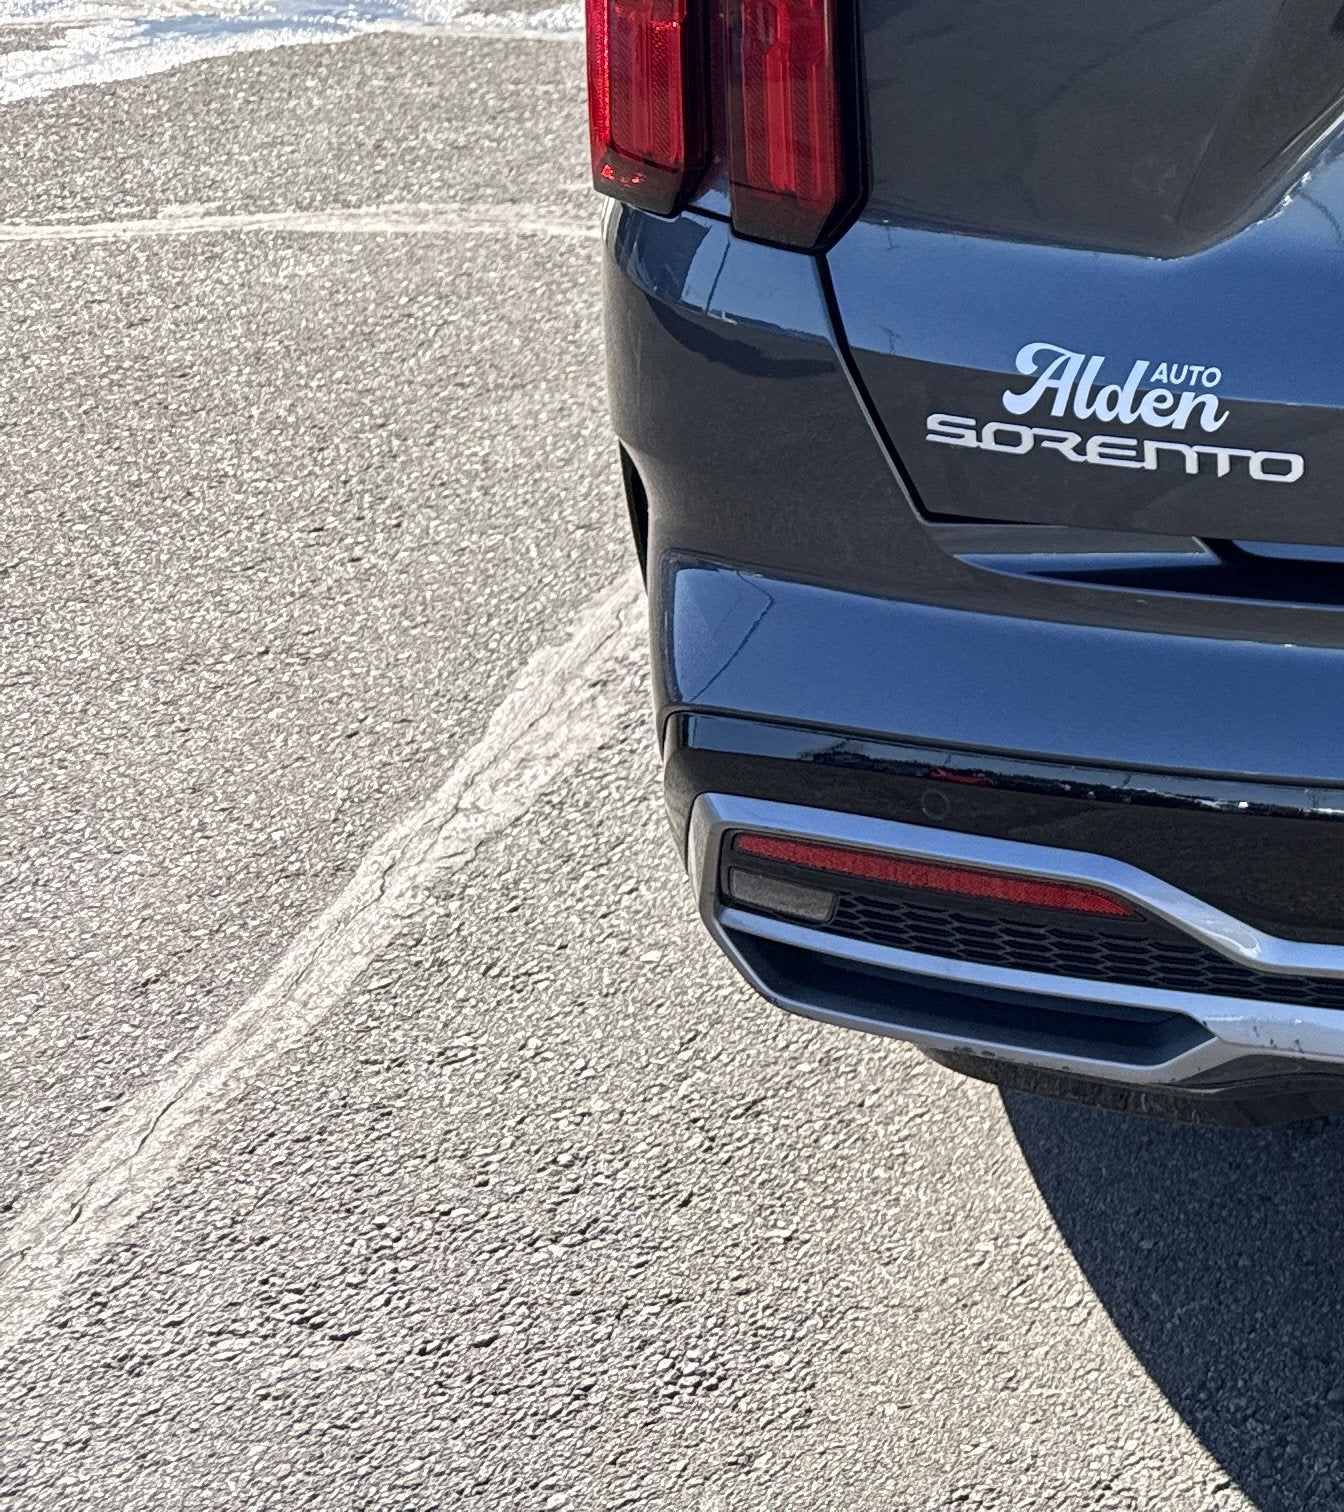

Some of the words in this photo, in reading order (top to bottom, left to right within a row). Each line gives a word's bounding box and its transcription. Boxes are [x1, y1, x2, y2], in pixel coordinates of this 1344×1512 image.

[1002, 342, 1230, 433] Alden
[1150, 362, 1222, 388] AUTO
[925, 413, 1305, 483] SORENTO
